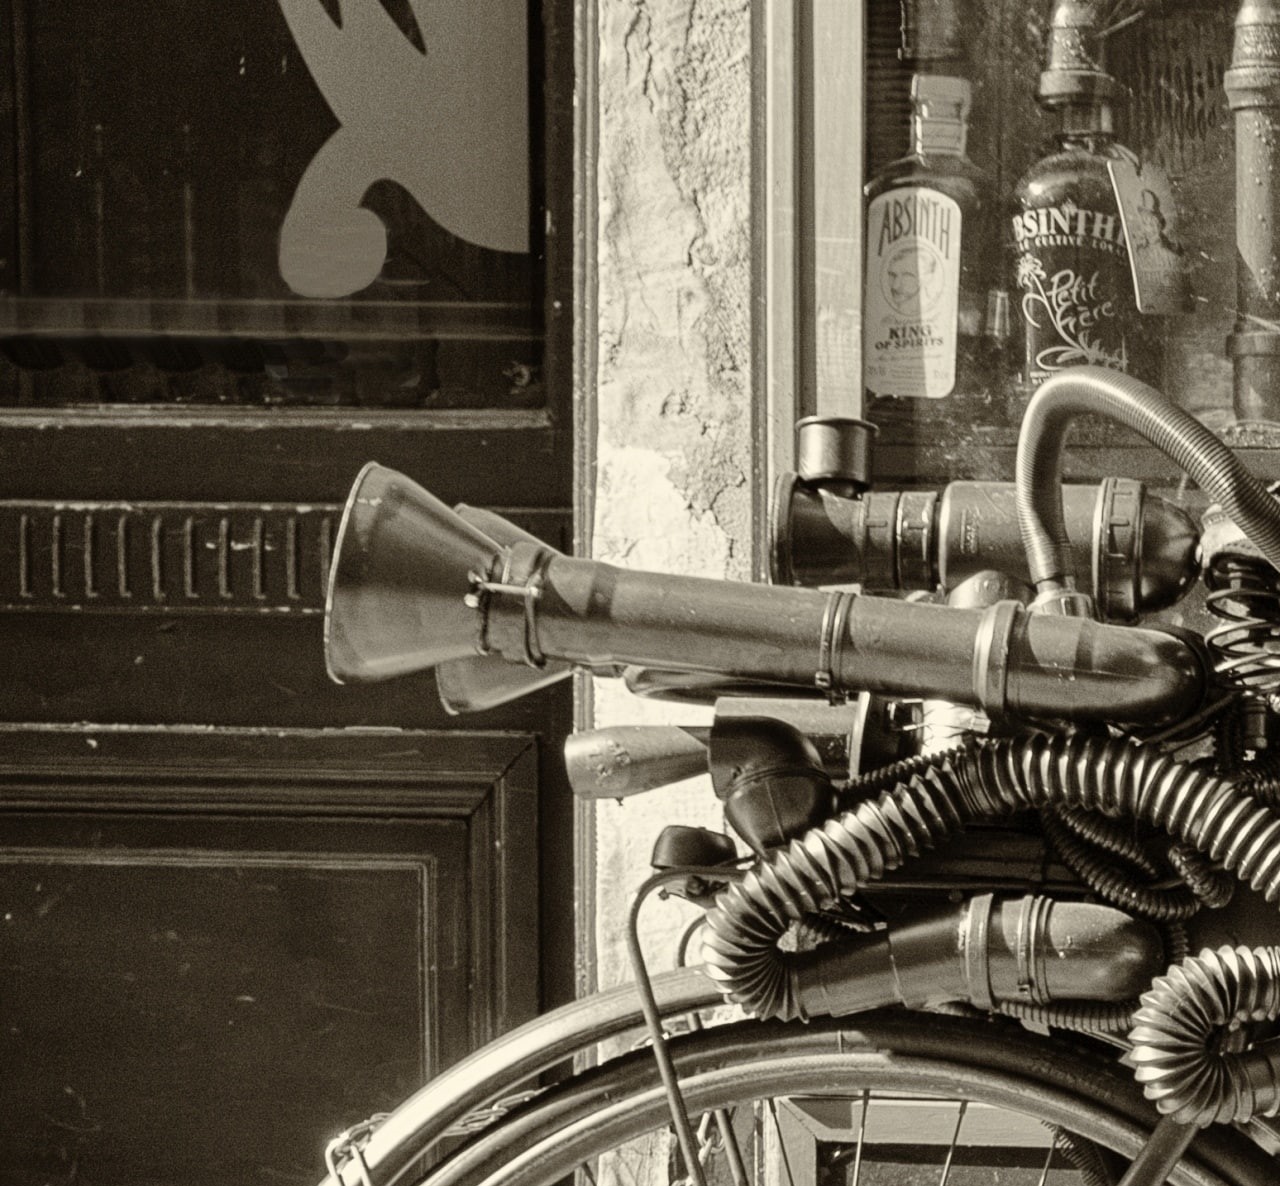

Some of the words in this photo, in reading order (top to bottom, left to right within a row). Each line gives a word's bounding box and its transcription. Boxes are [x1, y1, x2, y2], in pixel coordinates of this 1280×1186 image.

[878, 195, 952, 260] ABSINTH
[1012, 207, 1126, 248] BSINTH
[888, 324, 932, 340] KING
